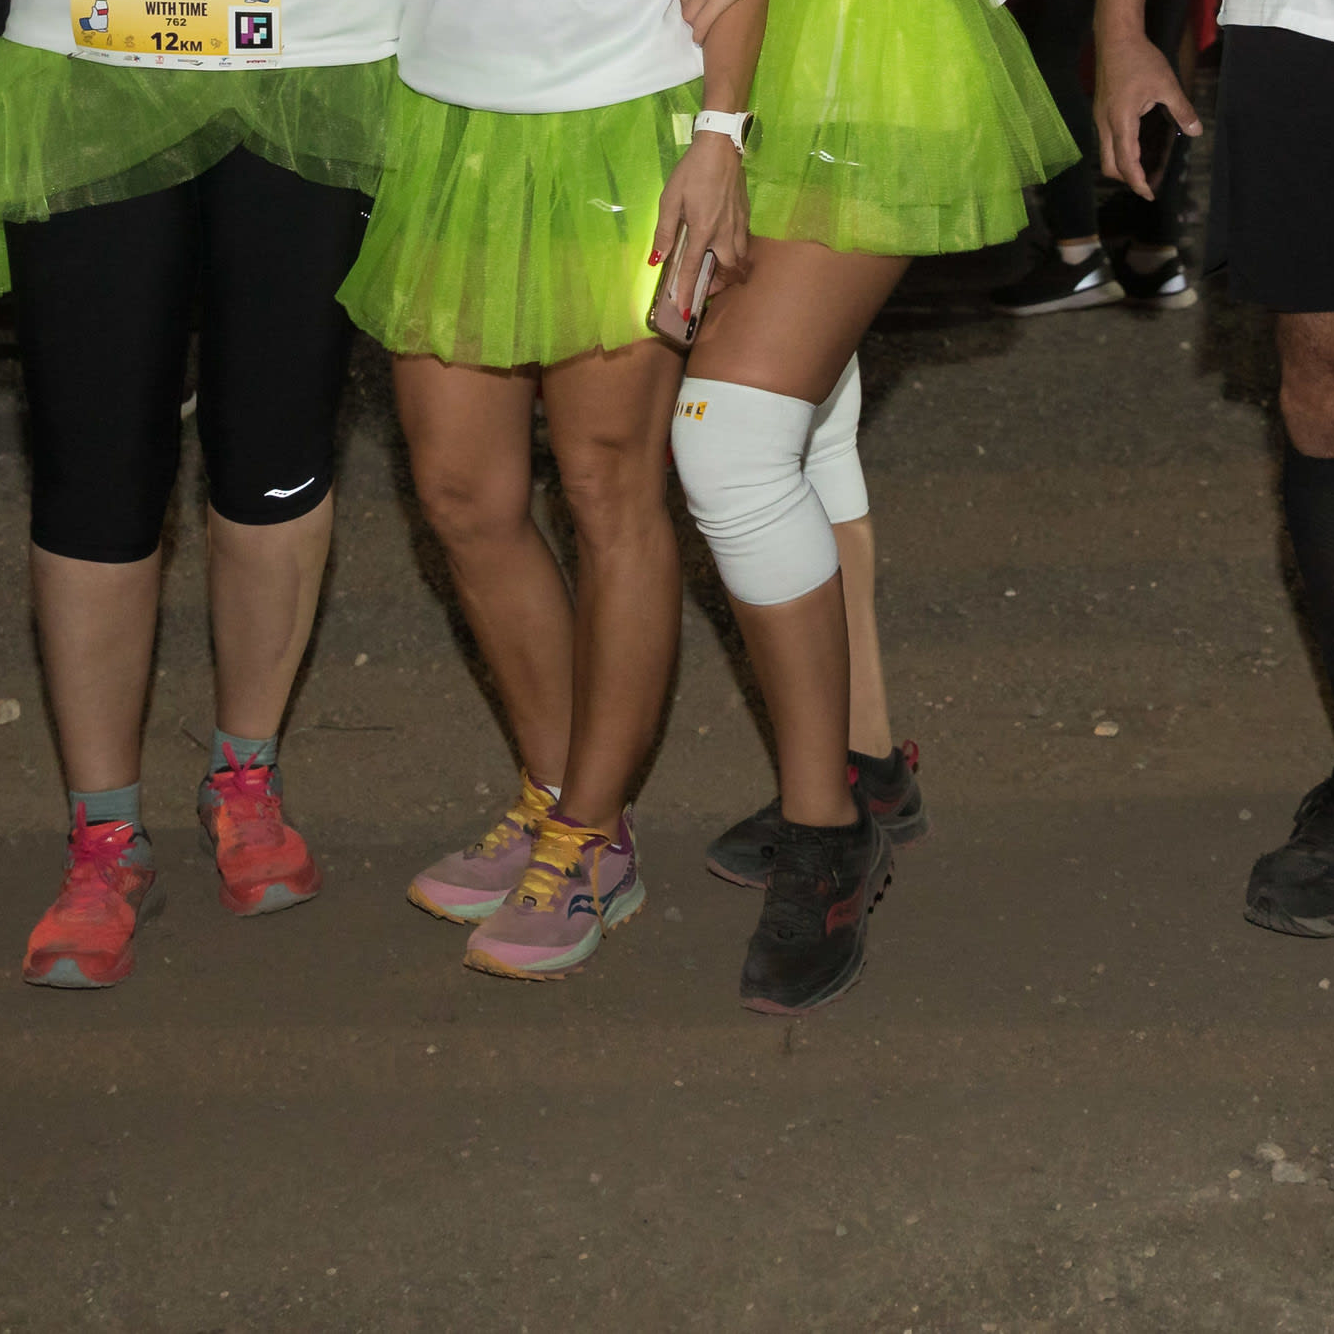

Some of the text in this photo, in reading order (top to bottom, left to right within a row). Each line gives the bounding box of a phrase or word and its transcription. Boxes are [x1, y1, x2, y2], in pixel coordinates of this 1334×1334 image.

[145, 1, 208, 17] WITH TIME
[165, 18, 187, 27] 762
